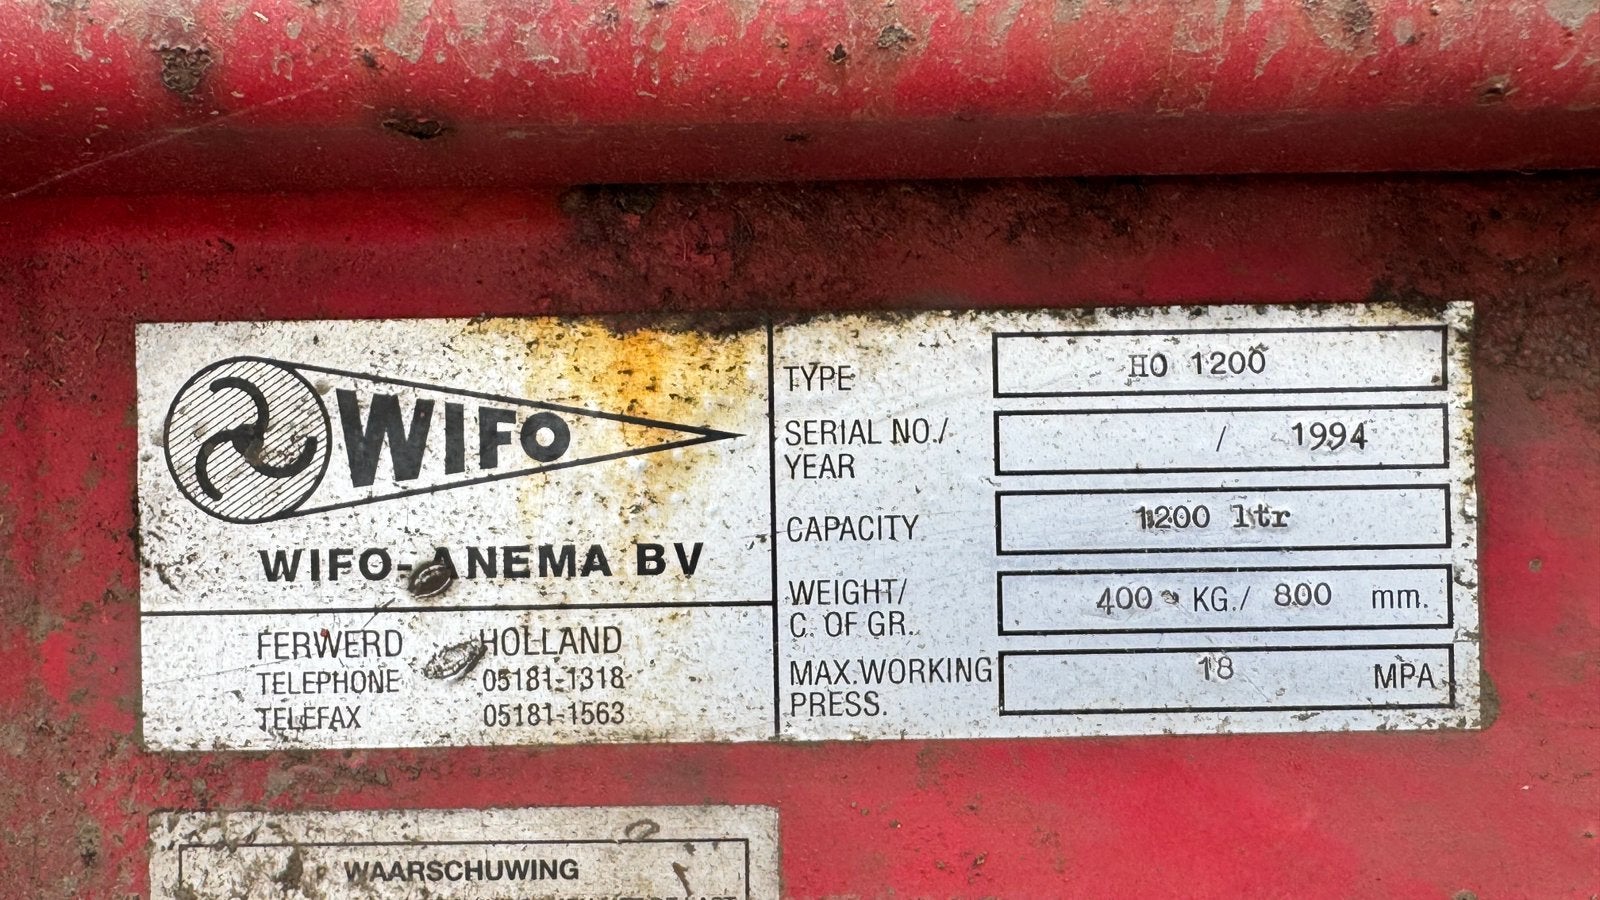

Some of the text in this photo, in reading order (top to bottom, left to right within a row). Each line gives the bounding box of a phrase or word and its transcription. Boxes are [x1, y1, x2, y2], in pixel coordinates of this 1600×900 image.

[1191, 350, 1266, 374] 1200
[784, 364, 852, 392] TYPE
[335, 388, 571, 487] WIFO
[785, 418, 949, 446] SERIAL NO./
[1216, 421, 1369, 452] / 1994
[784, 454, 855, 480] YEAR
[787, 515, 919, 542] CAPACITY
[1135, 505, 1211, 529] 1200
[258, 542, 704, 583] WIFO-ANEMA BV
[789, 579, 907, 606] WEIGHT/
[1096, 583, 1429, 615] 400 KG./ 800 mm.
[789, 610, 915, 637] C. OF GR.
[257, 626, 622, 660] FERWERD HOLLAND
[256, 666, 624, 695] TELEPHONE 05181-1318
[1198, 656, 1435, 689] 18 MPA
[255, 701, 625, 732] TELEFAX 05181-1563
[791, 691, 887, 718] PRESS.
[344, 859, 579, 882] WAARSCHUWING
